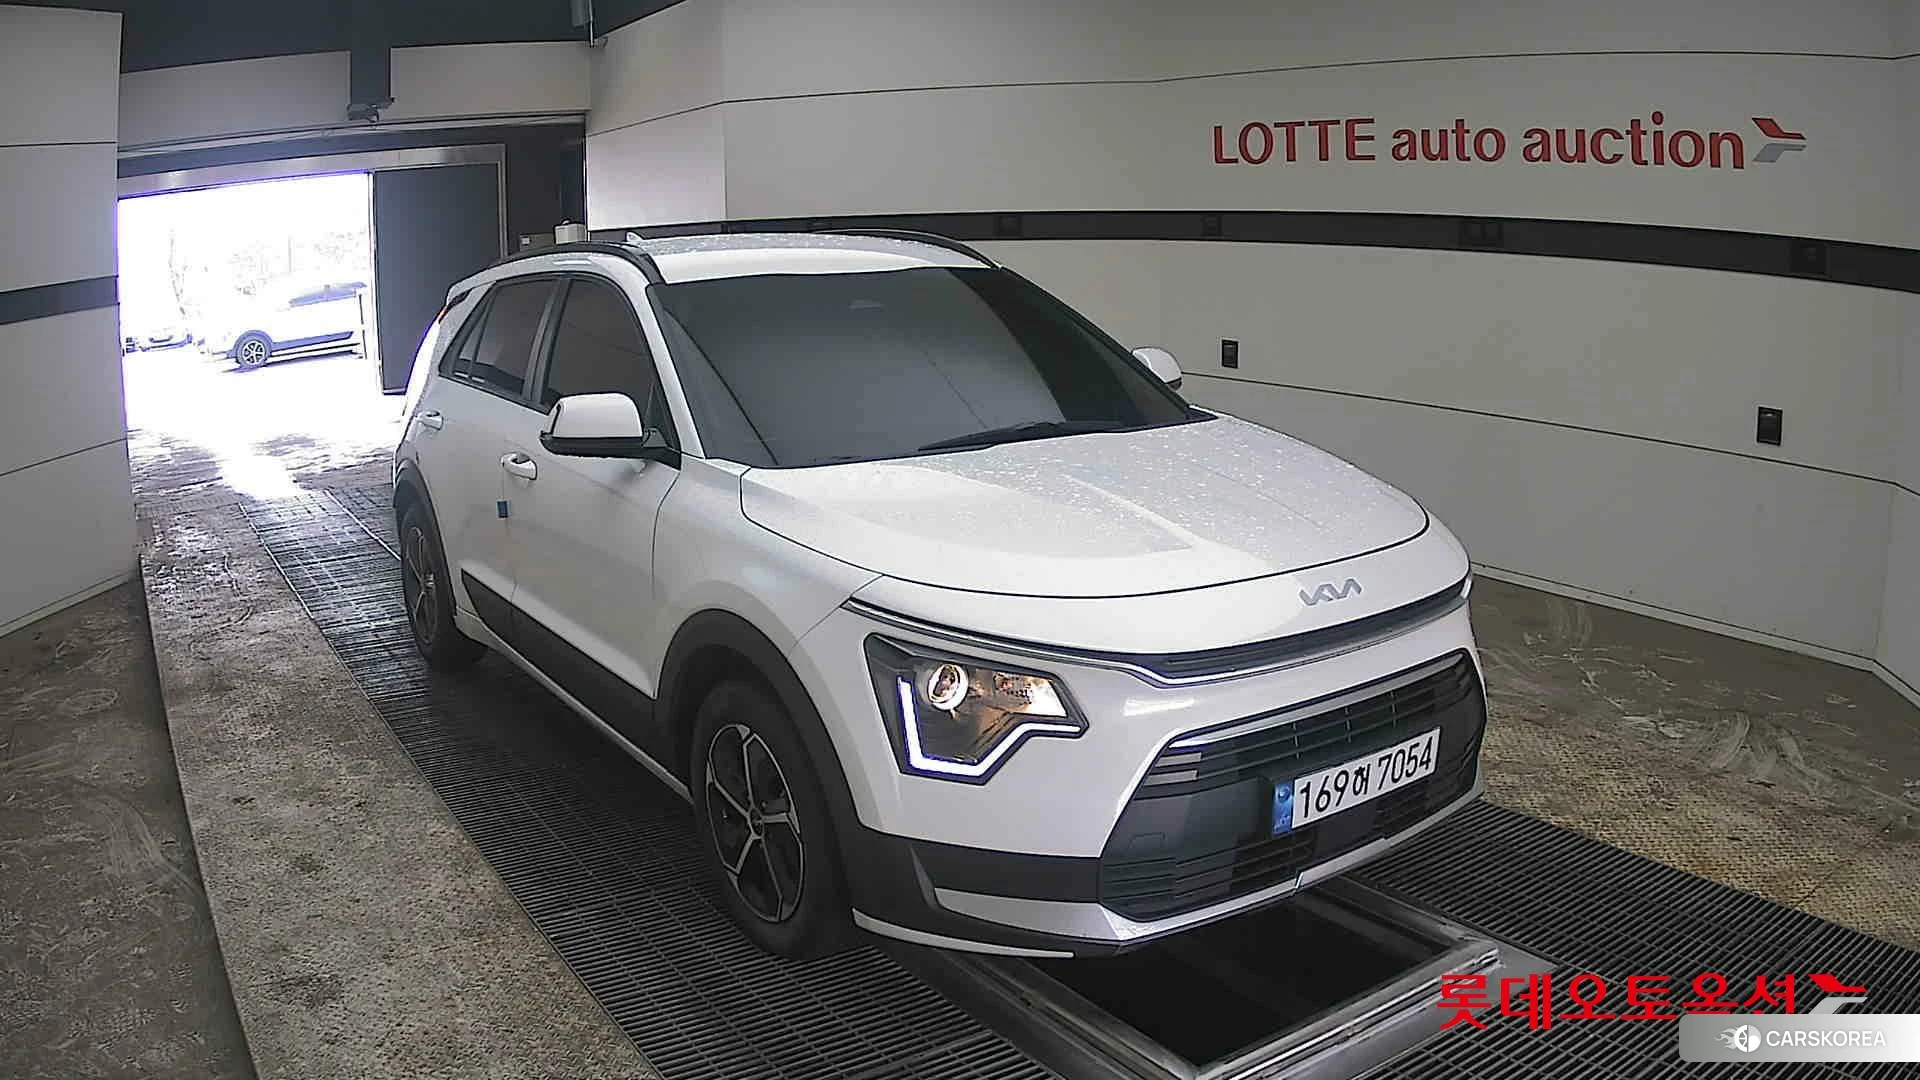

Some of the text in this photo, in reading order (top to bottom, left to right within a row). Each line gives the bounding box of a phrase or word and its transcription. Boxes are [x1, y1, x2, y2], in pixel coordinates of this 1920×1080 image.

[1212, 111, 1745, 170] LOTTE auto auction
[1299, 578, 1362, 606] KIA
[1377, 735, 1434, 791] 7054
